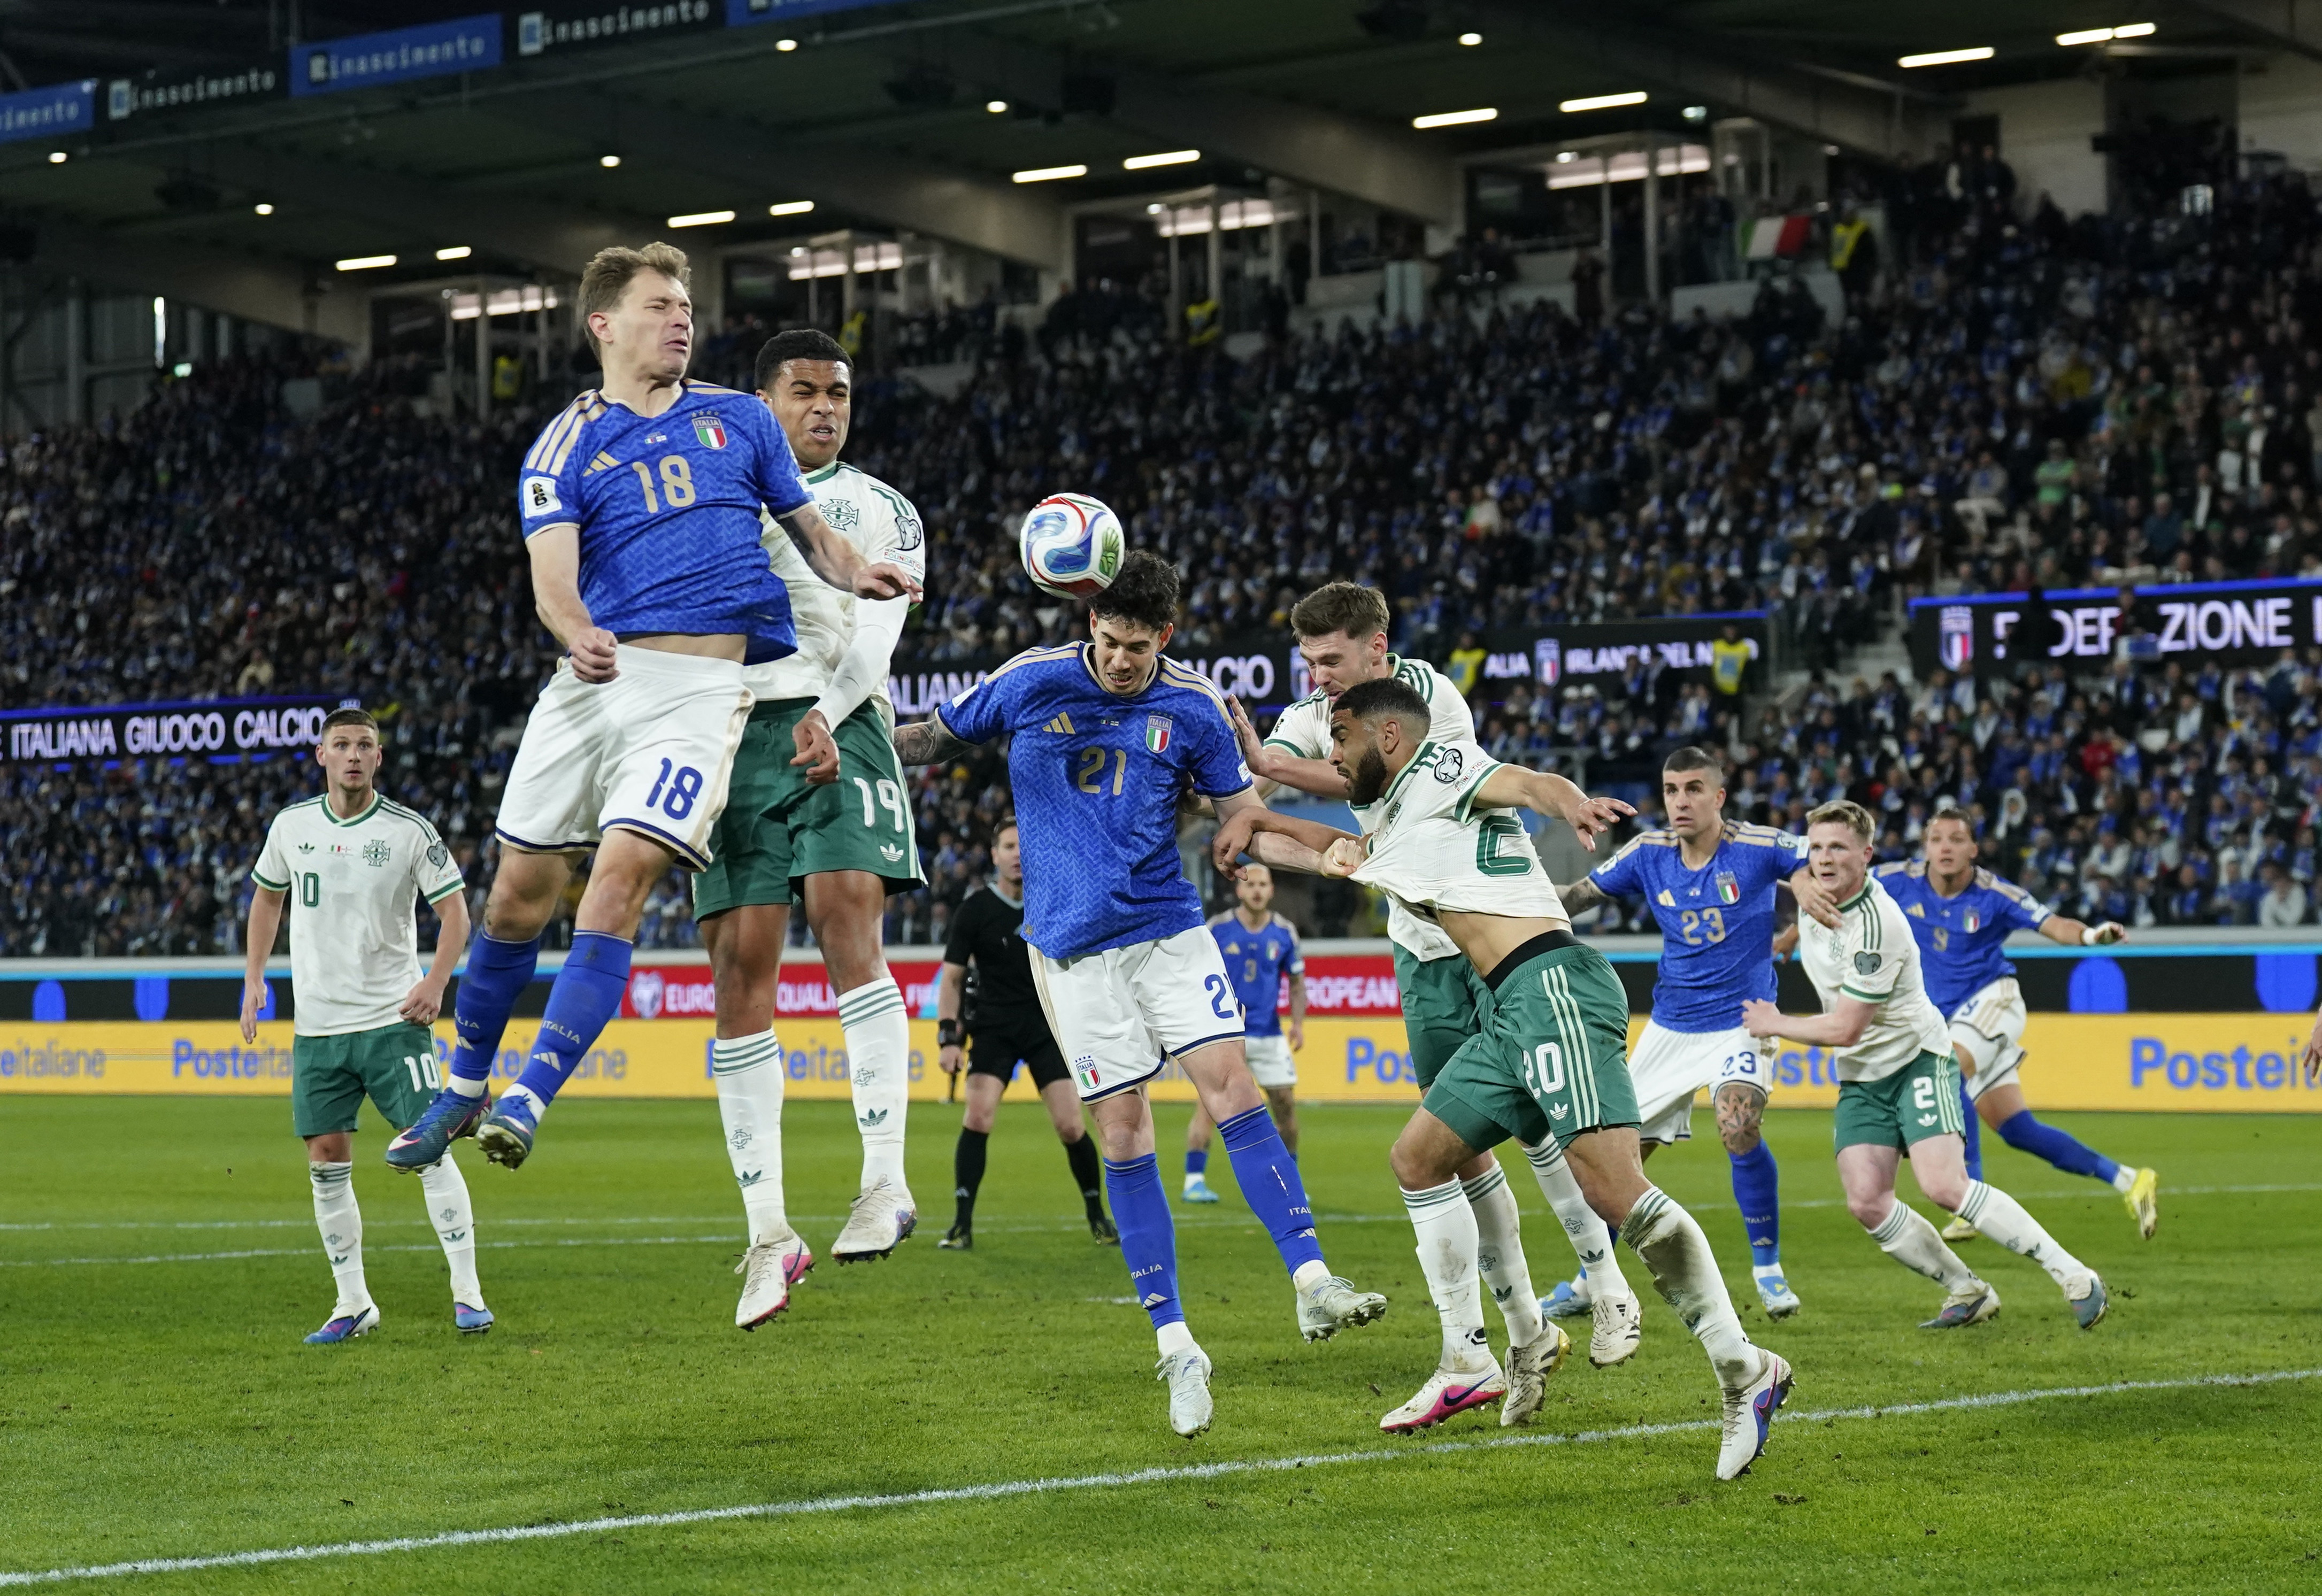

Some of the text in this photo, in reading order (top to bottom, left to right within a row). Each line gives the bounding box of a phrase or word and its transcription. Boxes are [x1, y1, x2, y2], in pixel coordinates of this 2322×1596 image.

[632, 454, 696, 513] 18
[884, 551, 924, 572] FOUNDATION
[11, 719, 117, 760] ITALIANA
[124, 712, 226, 754] GIUOCO
[233, 706, 327, 749] CALCIO
[1150, 718, 1169, 729] ITALIA
[1078, 747, 1126, 796] 21
[1457, 759, 1487, 792] FOUNDATION
[646, 758, 703, 820] 18
[853, 777, 904, 833] 19
[1681, 907, 1726, 945] 23
[665, 982, 838, 1012] EURO QUALI
[1277, 976, 1399, 1008] EROPEAN
[542, 1020, 580, 1044] ITALIA
[0, 1037, 106, 1077] eitaliane
[172, 1037, 294, 1077] Posteita
[404, 1052, 441, 1093] 10
[1077, 1062, 1094, 1071] ITALIA
[1523, 1042, 1566, 1100] 20
[1721, 1051, 1757, 1076] 23
[1913, 1076, 1936, 1109] 2
[1289, 1207, 1312, 1216] ITAL
[1131, 1263, 1163, 1281] ITALIA
